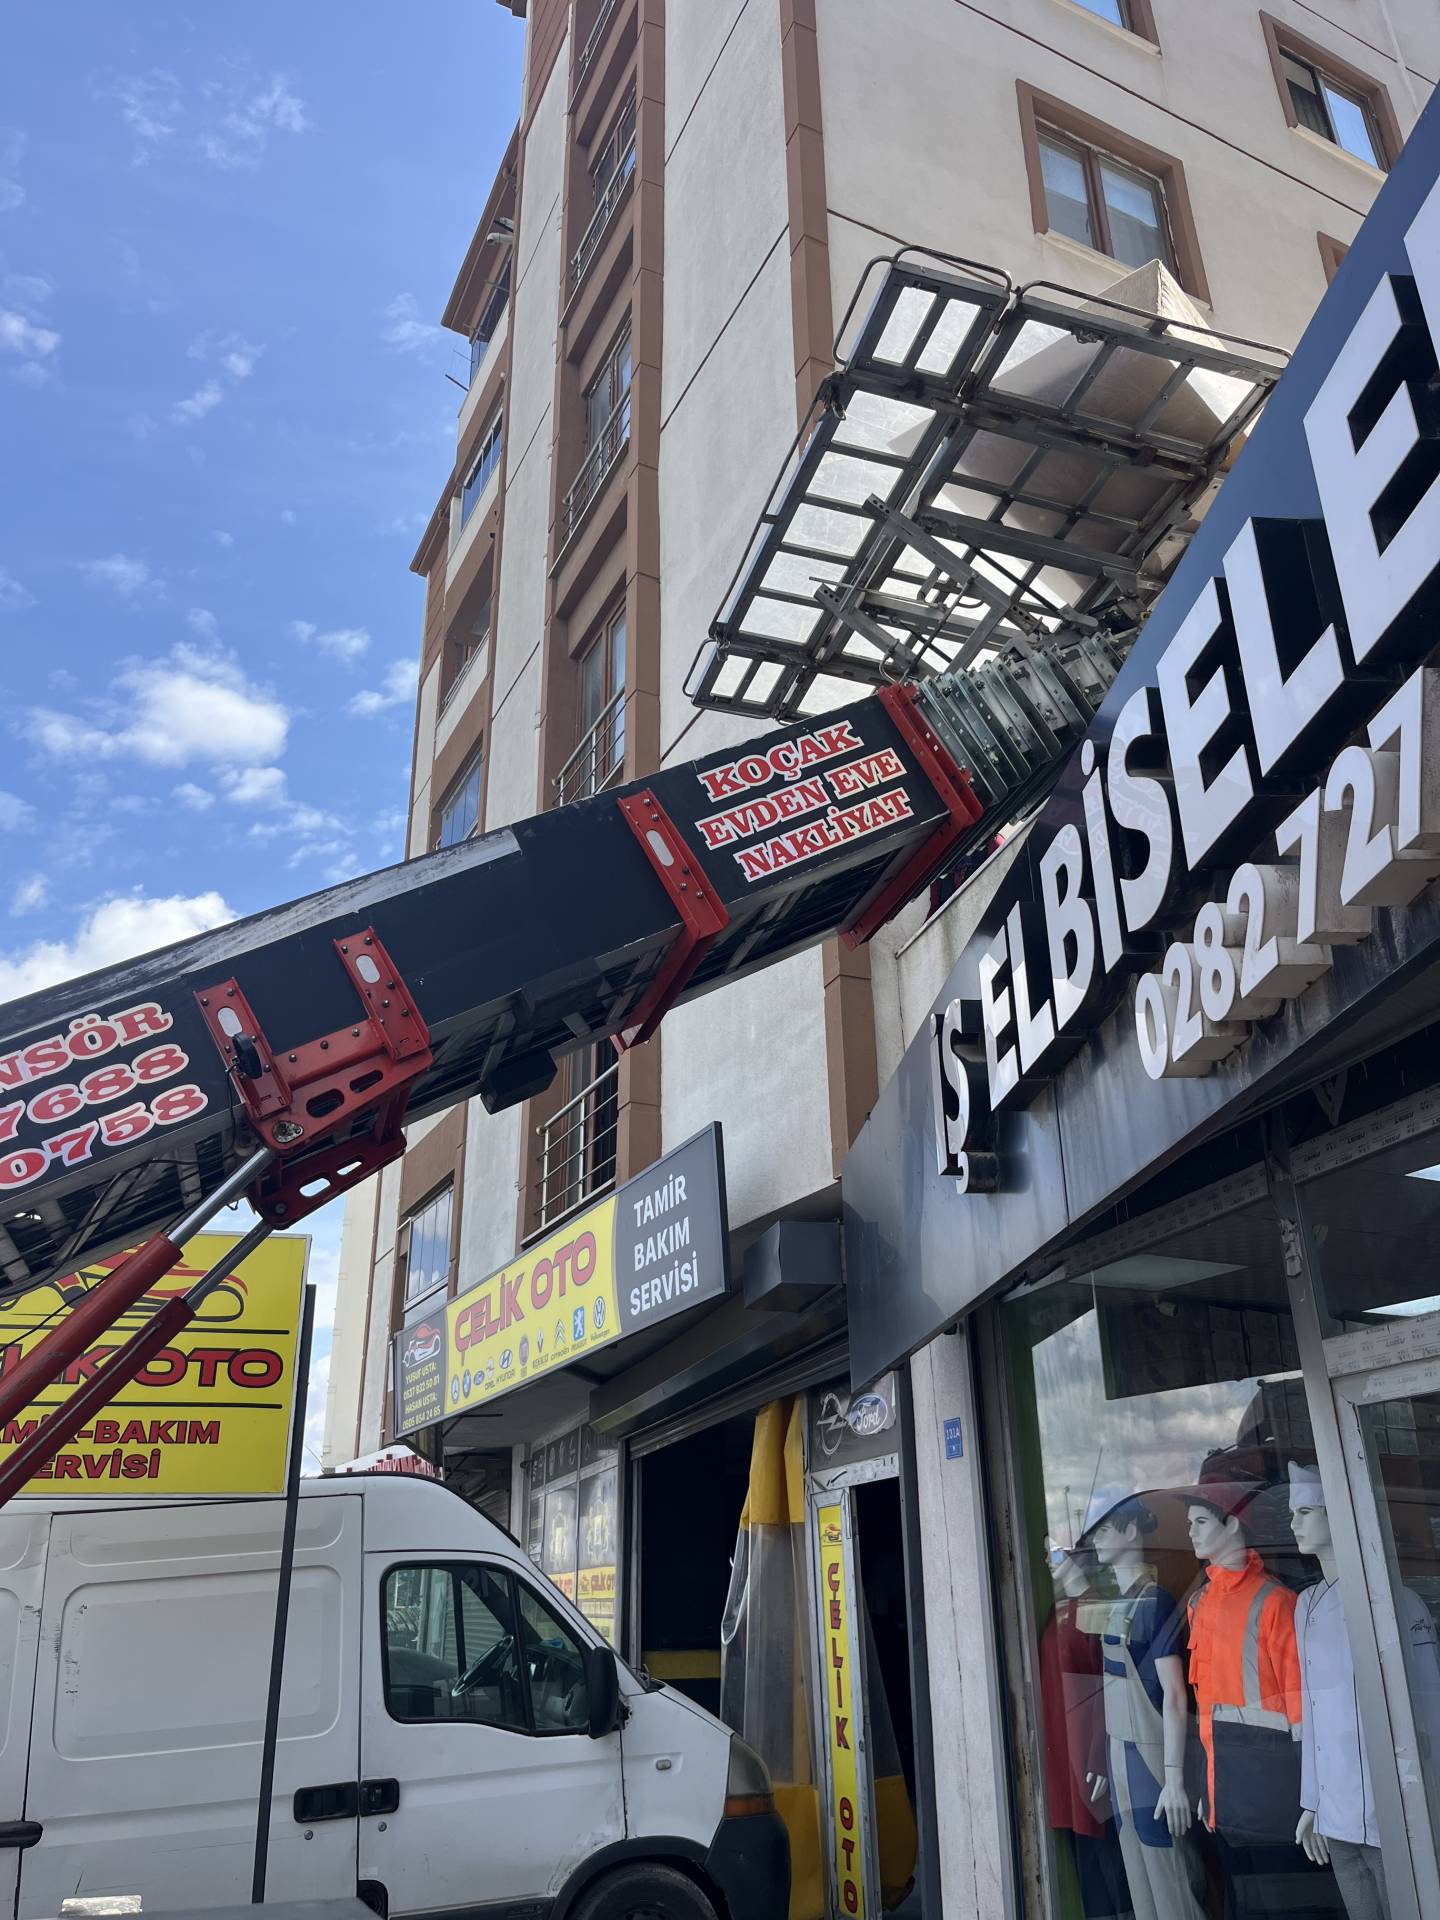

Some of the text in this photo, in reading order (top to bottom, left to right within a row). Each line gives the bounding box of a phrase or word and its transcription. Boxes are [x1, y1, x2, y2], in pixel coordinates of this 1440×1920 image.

[930, 998, 971, 1194] İŞ
[979, 172, 1440, 1112] ELBİSELE
[695, 748, 907, 850] EVDEN EVE
[698, 721, 864, 802] KOÇAK
[733, 787, 914, 882] NAKLİYAT
[634, 1173, 687, 1227] TAMİR
[531, 1231, 596, 1309] OTO
[630, 1250, 698, 1316] SERVİSİ
[634, 1216, 690, 1272] BAKIM
[133, 1347, 283, 1389] OTO
[30, 1448, 161, 1479] ERVİSİ
[827, 1562, 859, 1914] ÇELİK OTO
